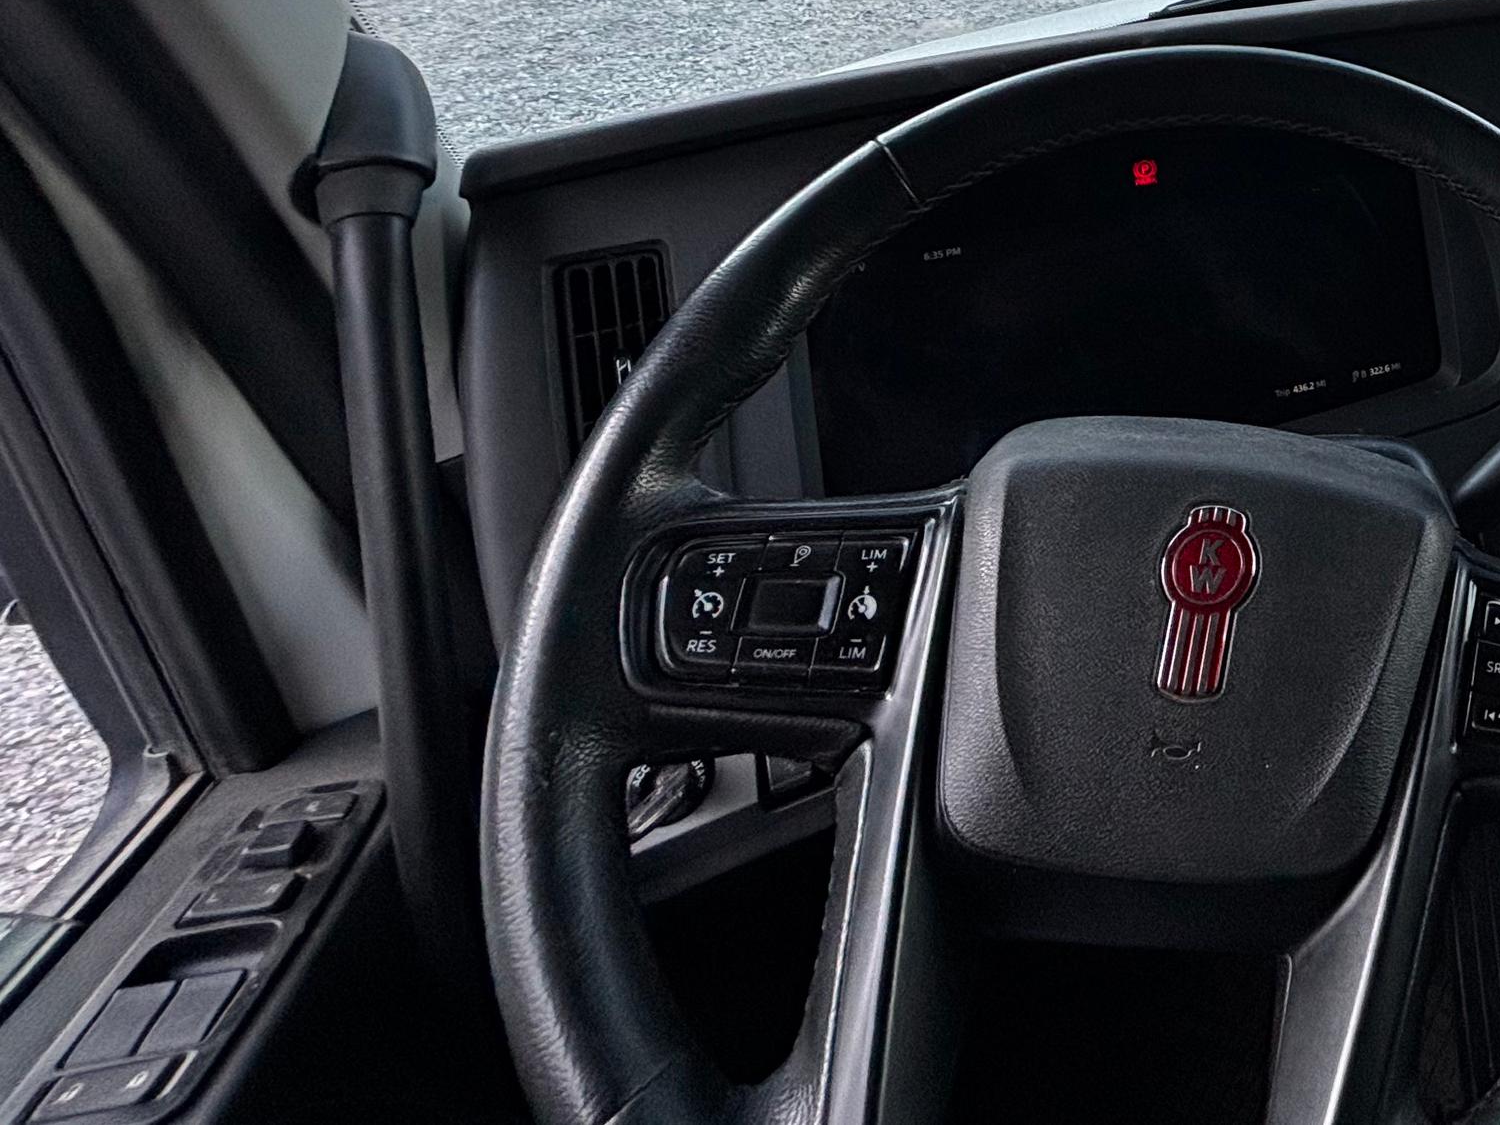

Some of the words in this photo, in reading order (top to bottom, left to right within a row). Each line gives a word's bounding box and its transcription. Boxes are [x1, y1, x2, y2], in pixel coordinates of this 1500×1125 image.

[945, 246, 962, 258] PM
[1369, 363, 1391, 377] 322.6
[1292, 380, 1315, 394] 436.2
[707, 552, 737, 565] SET
[861, 548, 888, 561] LIM
[1199, 538, 1224, 566] K
[1189, 565, 1227, 594] W
[686, 638, 717, 653] RES
[753, 647, 797, 660] ON/OFF
[838, 646, 866, 660] LIM
